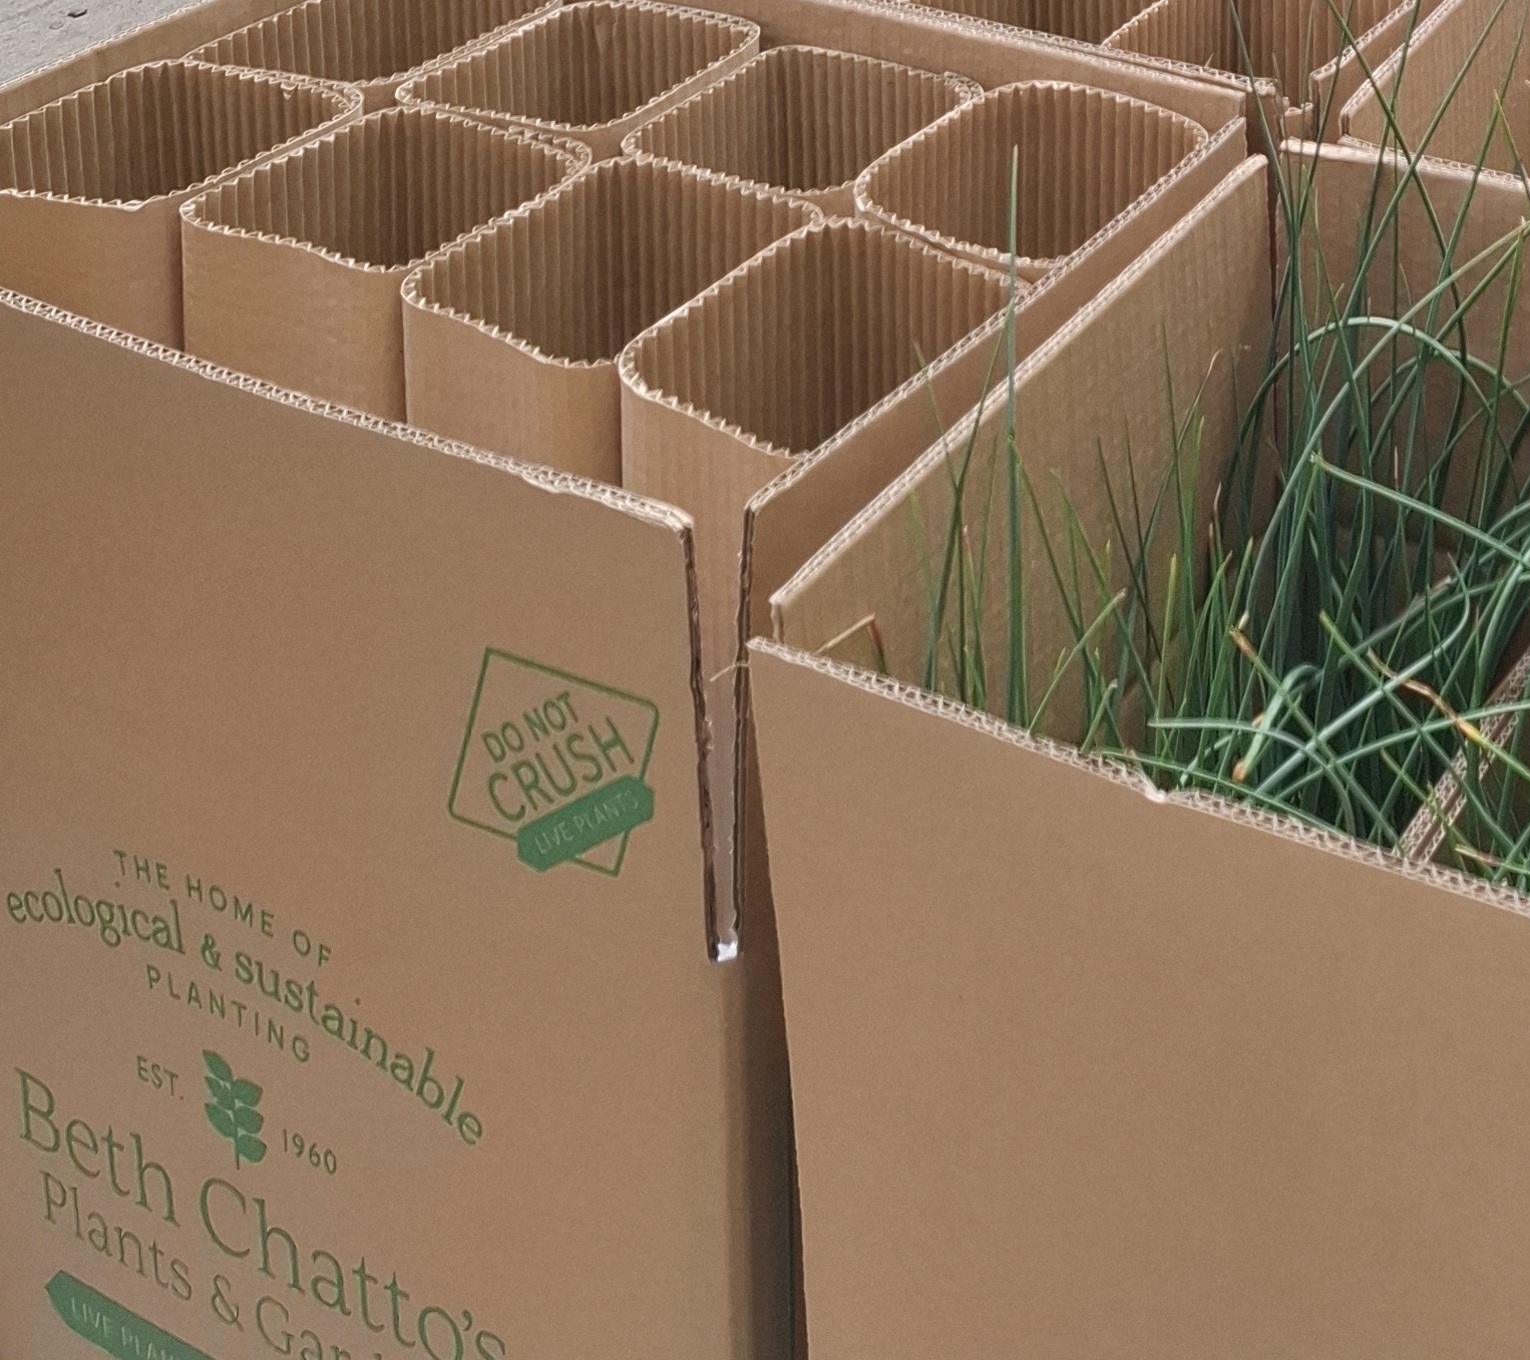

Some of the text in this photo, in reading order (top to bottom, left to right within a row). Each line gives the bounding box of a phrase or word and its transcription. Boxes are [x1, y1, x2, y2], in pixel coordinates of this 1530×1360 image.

[481, 691, 579, 764] DO NOT
[488, 715, 635, 822] CRUSH
[534, 788, 640, 855] LIVE PLANTS
[113, 849, 332, 968] THE HOME OF
[6, 867, 483, 1146] ecological & sustainable
[147, 964, 310, 1063] PLANTING
[137, 1055, 338, 1176] EST. 1960
[14, 1066, 506, 1360] Beth Chatto's
[39, 1171, 193, 1301] Plants
[211, 1274, 245, 1333] &
[70, 1296, 113, 1339] LIVE
